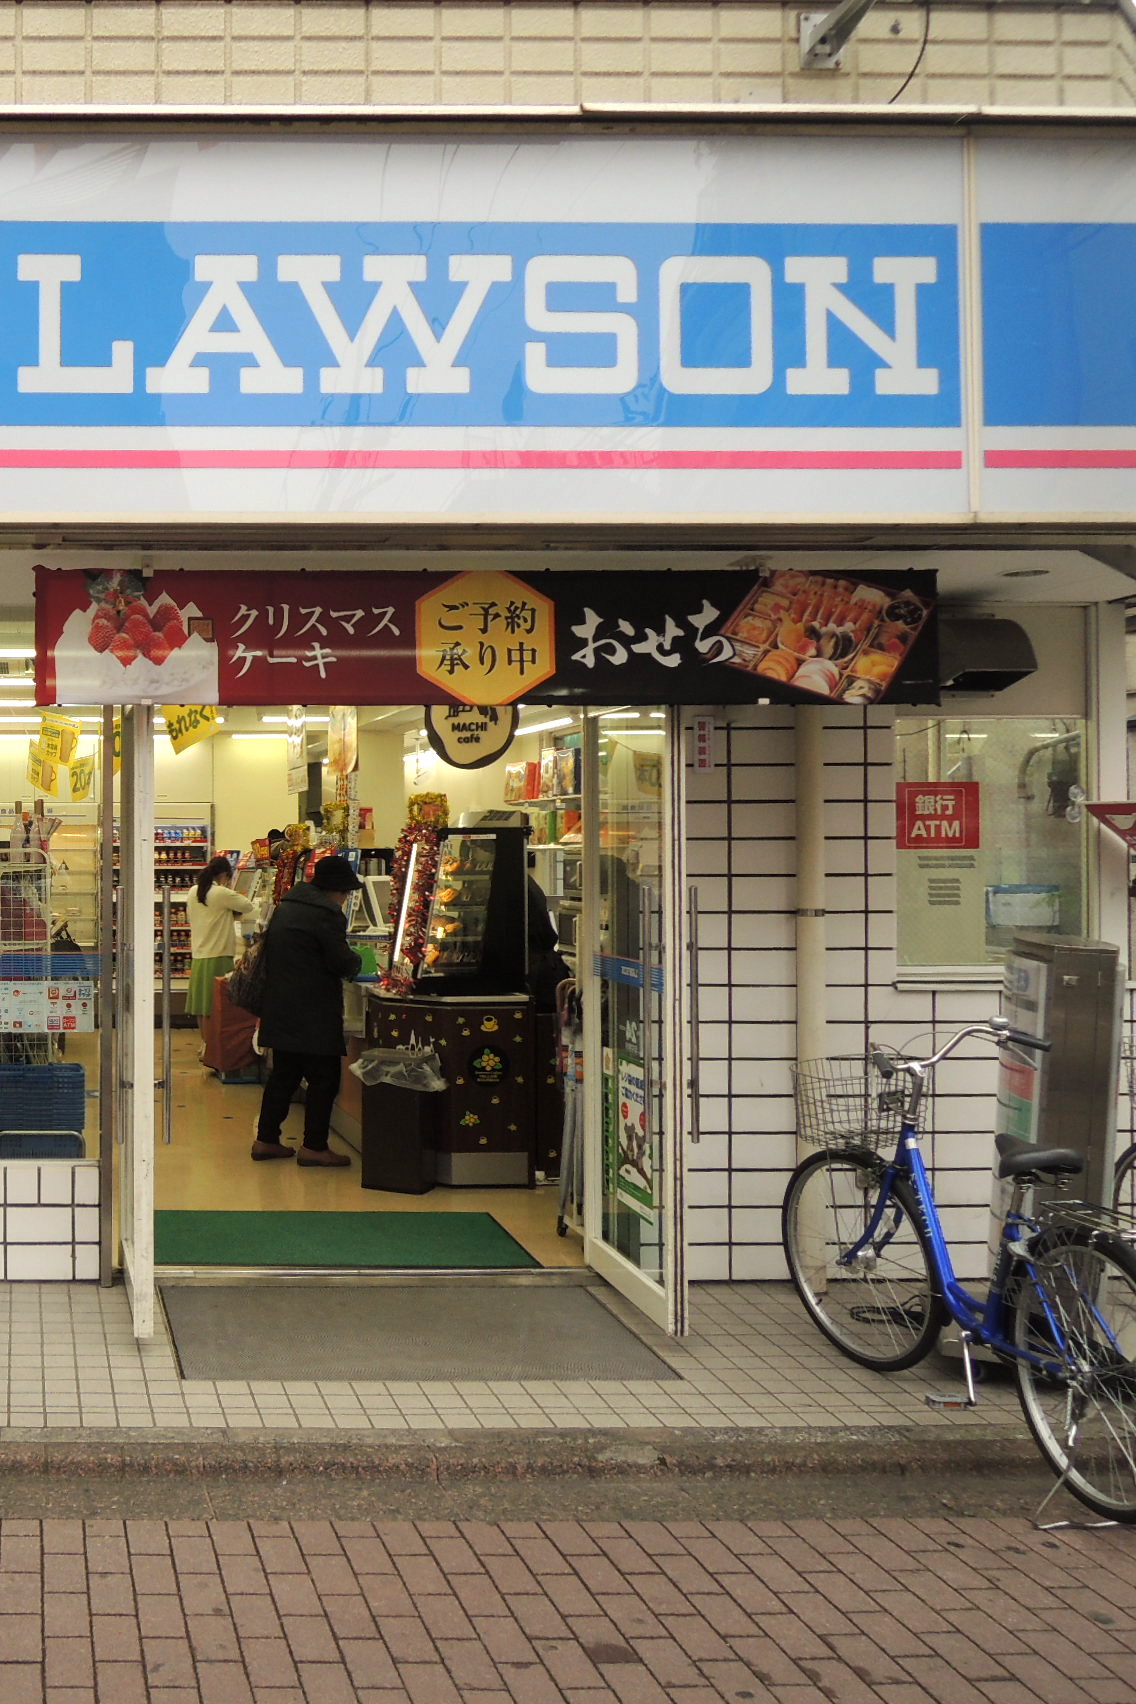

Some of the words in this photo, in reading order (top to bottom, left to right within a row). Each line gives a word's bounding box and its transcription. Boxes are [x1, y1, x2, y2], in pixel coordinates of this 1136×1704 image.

[16, 253, 940, 395] LAWSON
[229, 602, 401, 640] クリスマス
[437, 600, 538, 636] ご予約
[570, 599, 737, 668] おせち
[229, 642, 338, 679] ケーキ
[435, 641, 538, 677] 承り中
[167, 705, 211, 741] もれなく
[451, 721, 488, 732] MACHI
[457, 733, 481, 744] café
[915, 794, 956, 816] 銀行
[910, 820, 961, 838] ATM
